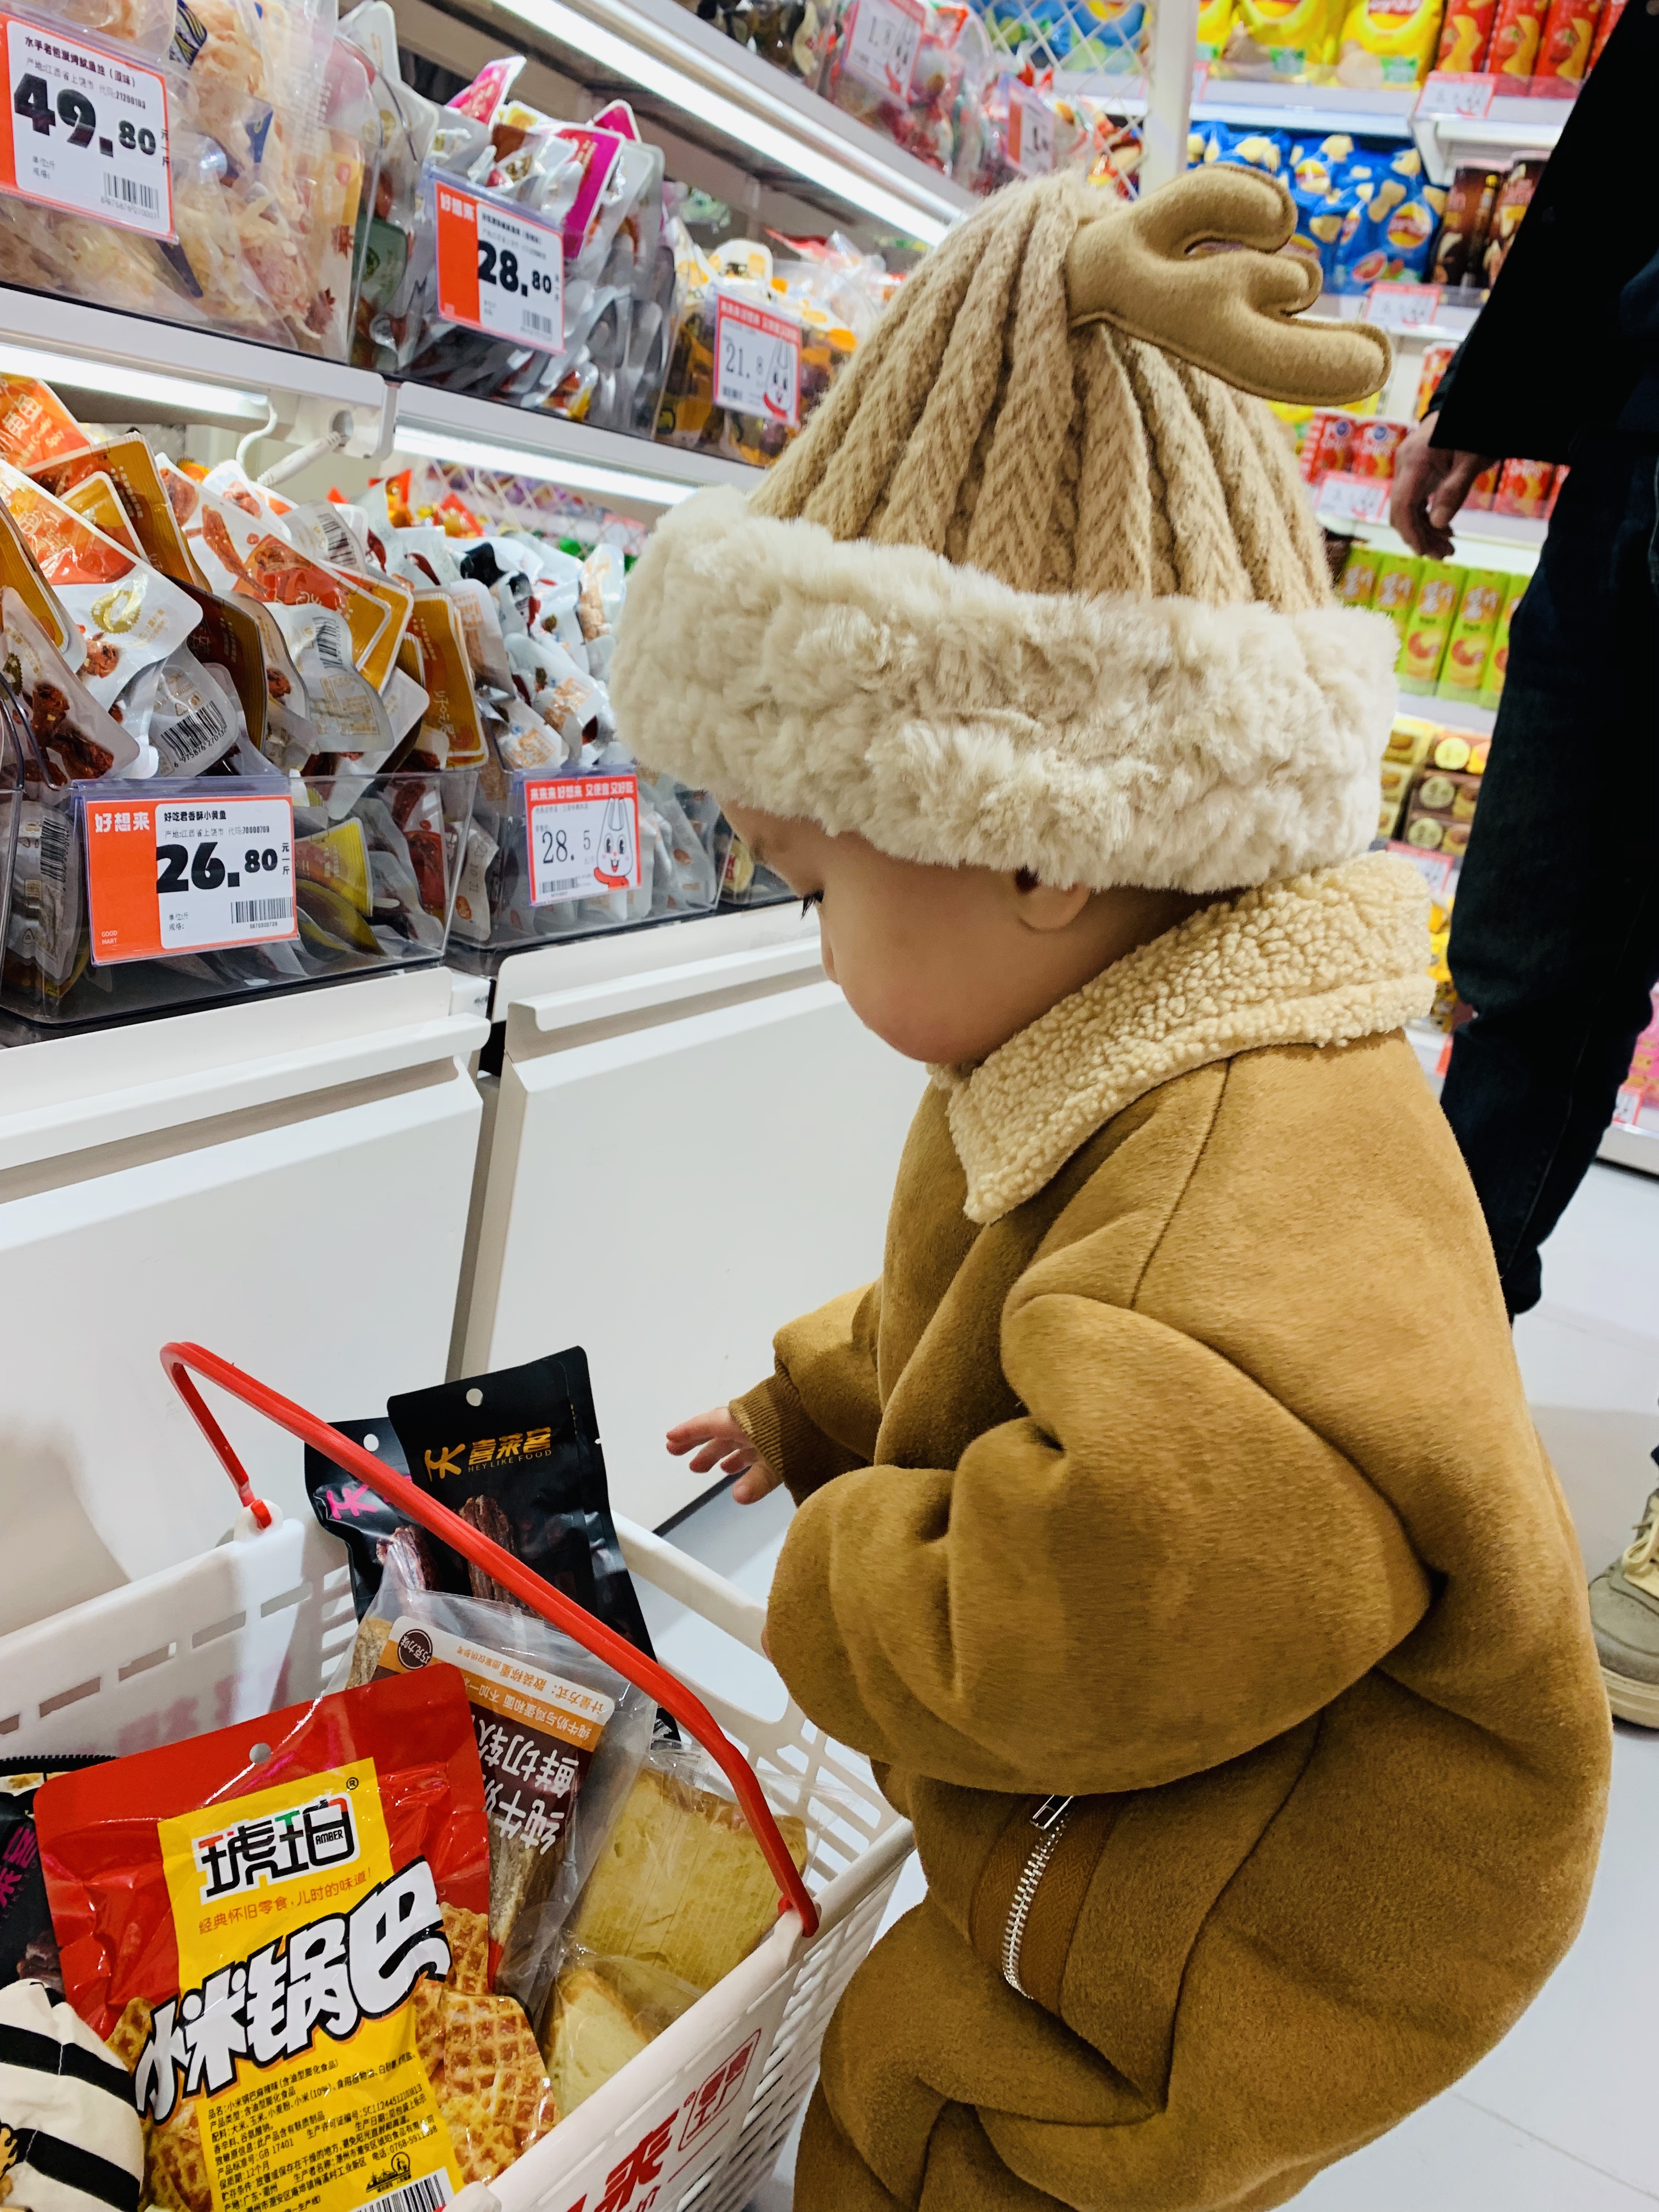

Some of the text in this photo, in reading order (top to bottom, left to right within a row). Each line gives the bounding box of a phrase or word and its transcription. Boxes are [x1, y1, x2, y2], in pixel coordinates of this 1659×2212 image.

[95, 812, 149, 832] 好想来
[164, 810, 226, 822] 好吃君香酥小黄鱼
[491, 1457, 514, 1468] LIKE
[518, 1449, 551, 1462] FOOD
[401, 1635, 431, 1664] 巧克力味
[472, 1716, 578, 1798] 鲜切软
[198, 1798, 354, 1898] 琥珀
[315, 1830, 343, 1845] AMBER
[137, 1857, 450, 2122] 小米锅巴
